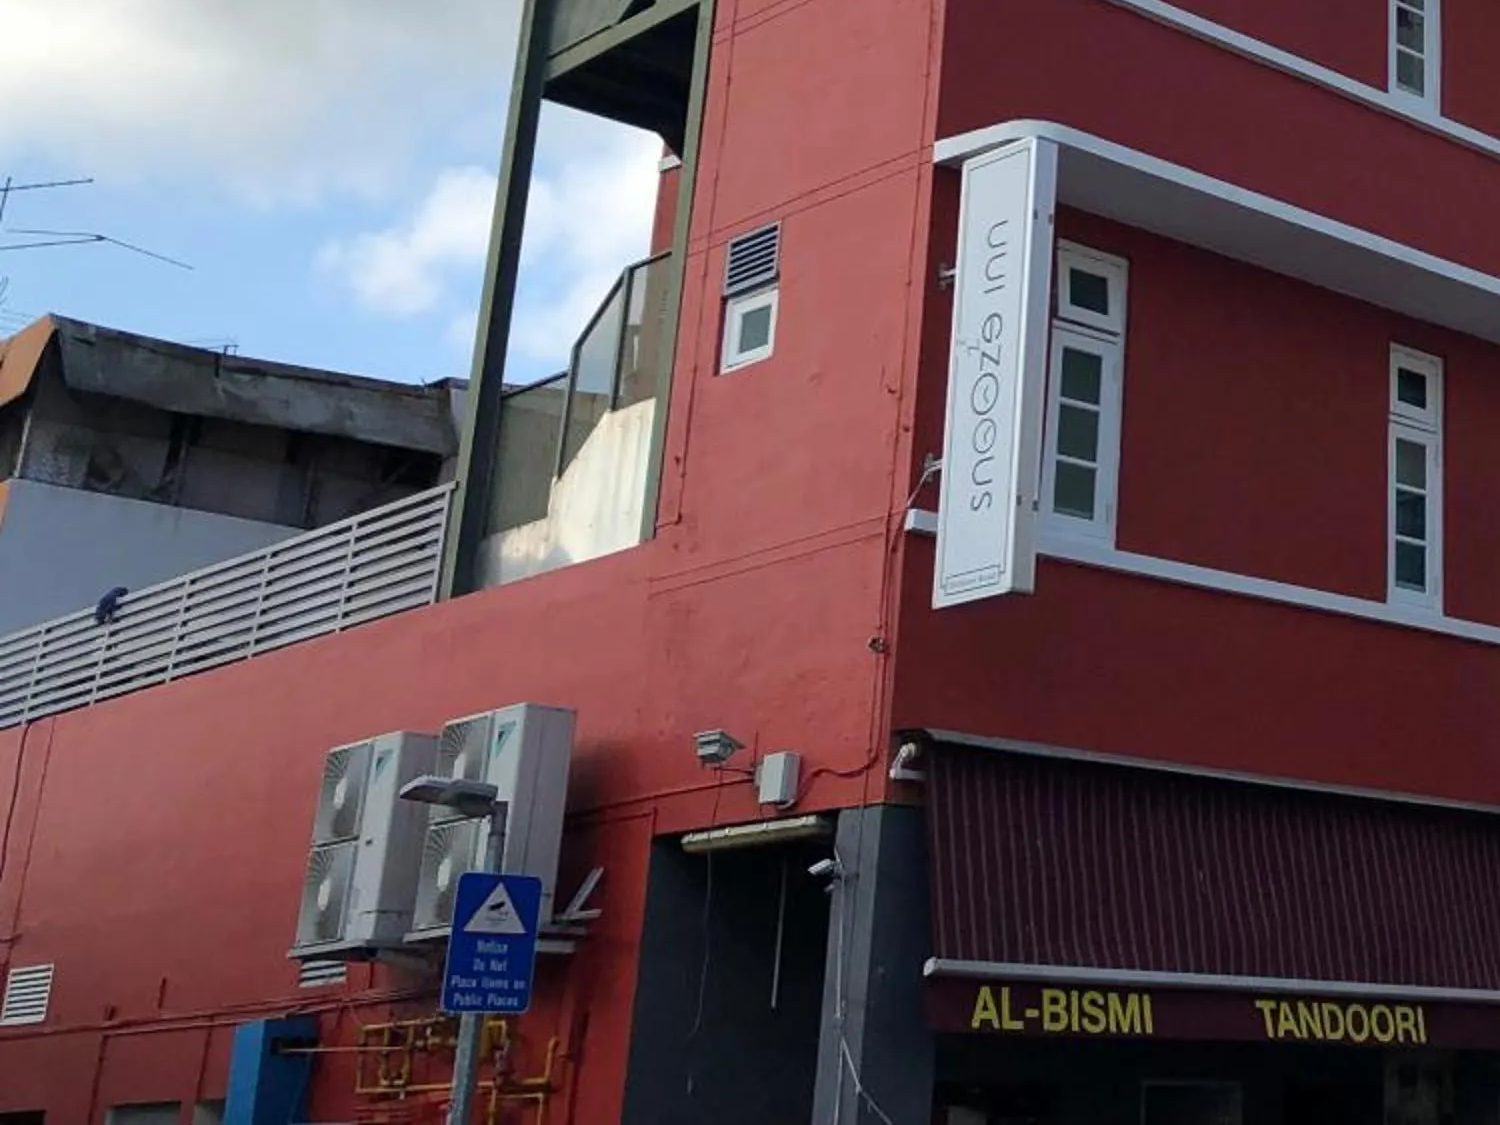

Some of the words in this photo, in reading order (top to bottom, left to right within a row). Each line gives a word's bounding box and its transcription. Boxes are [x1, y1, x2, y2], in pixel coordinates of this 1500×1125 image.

[452, 974, 476, 988] Place
[453, 992, 482, 1006] Public
[487, 993, 518, 1006] Places
[970, 986, 1153, 1034] AL-BISMI
[1256, 1000, 1427, 1043] TANDOORI
